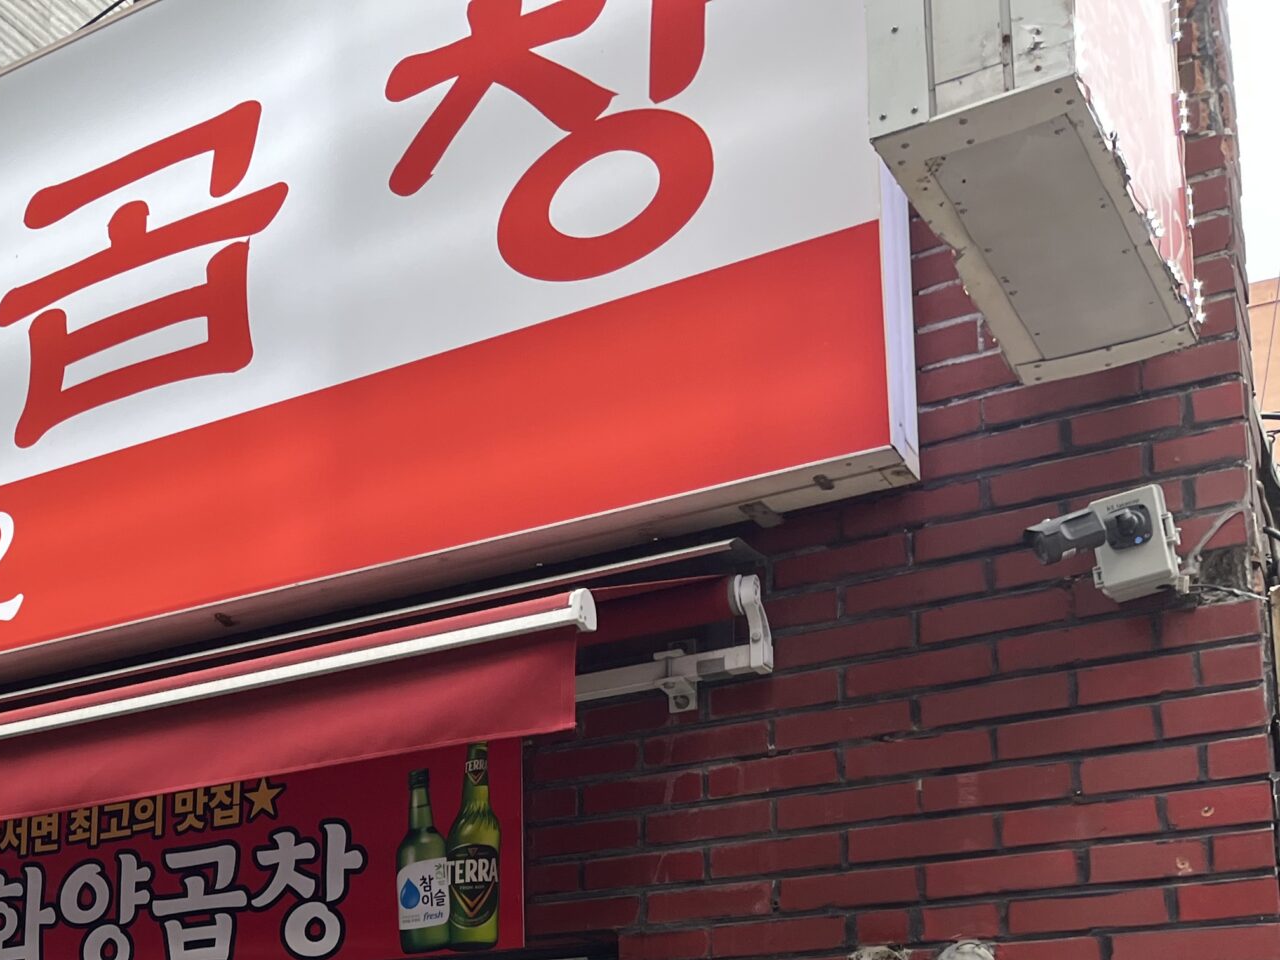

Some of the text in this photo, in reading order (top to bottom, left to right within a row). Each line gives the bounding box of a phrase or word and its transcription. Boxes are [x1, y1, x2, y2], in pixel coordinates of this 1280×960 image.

[0, 782, 242, 856] 서면 최고의 맛집
[447, 858, 499, 886] TERRA
